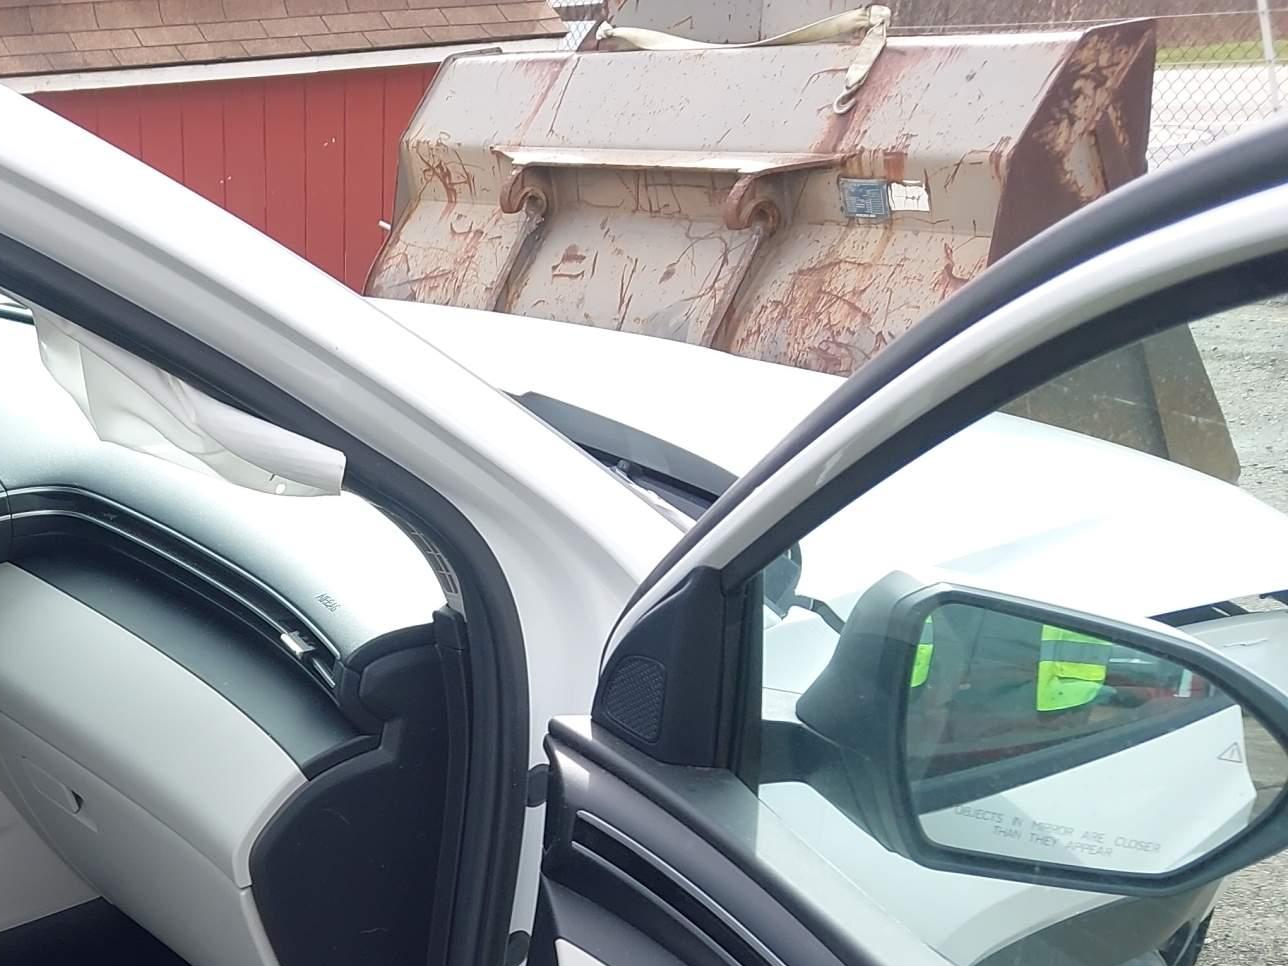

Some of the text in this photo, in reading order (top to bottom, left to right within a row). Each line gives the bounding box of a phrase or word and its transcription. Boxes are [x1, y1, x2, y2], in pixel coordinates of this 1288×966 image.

[955, 806, 1161, 853] OBJECTS IN MIRROR ARE CLOSER
[992, 825, 1113, 859] THAN THEY APPEAR
